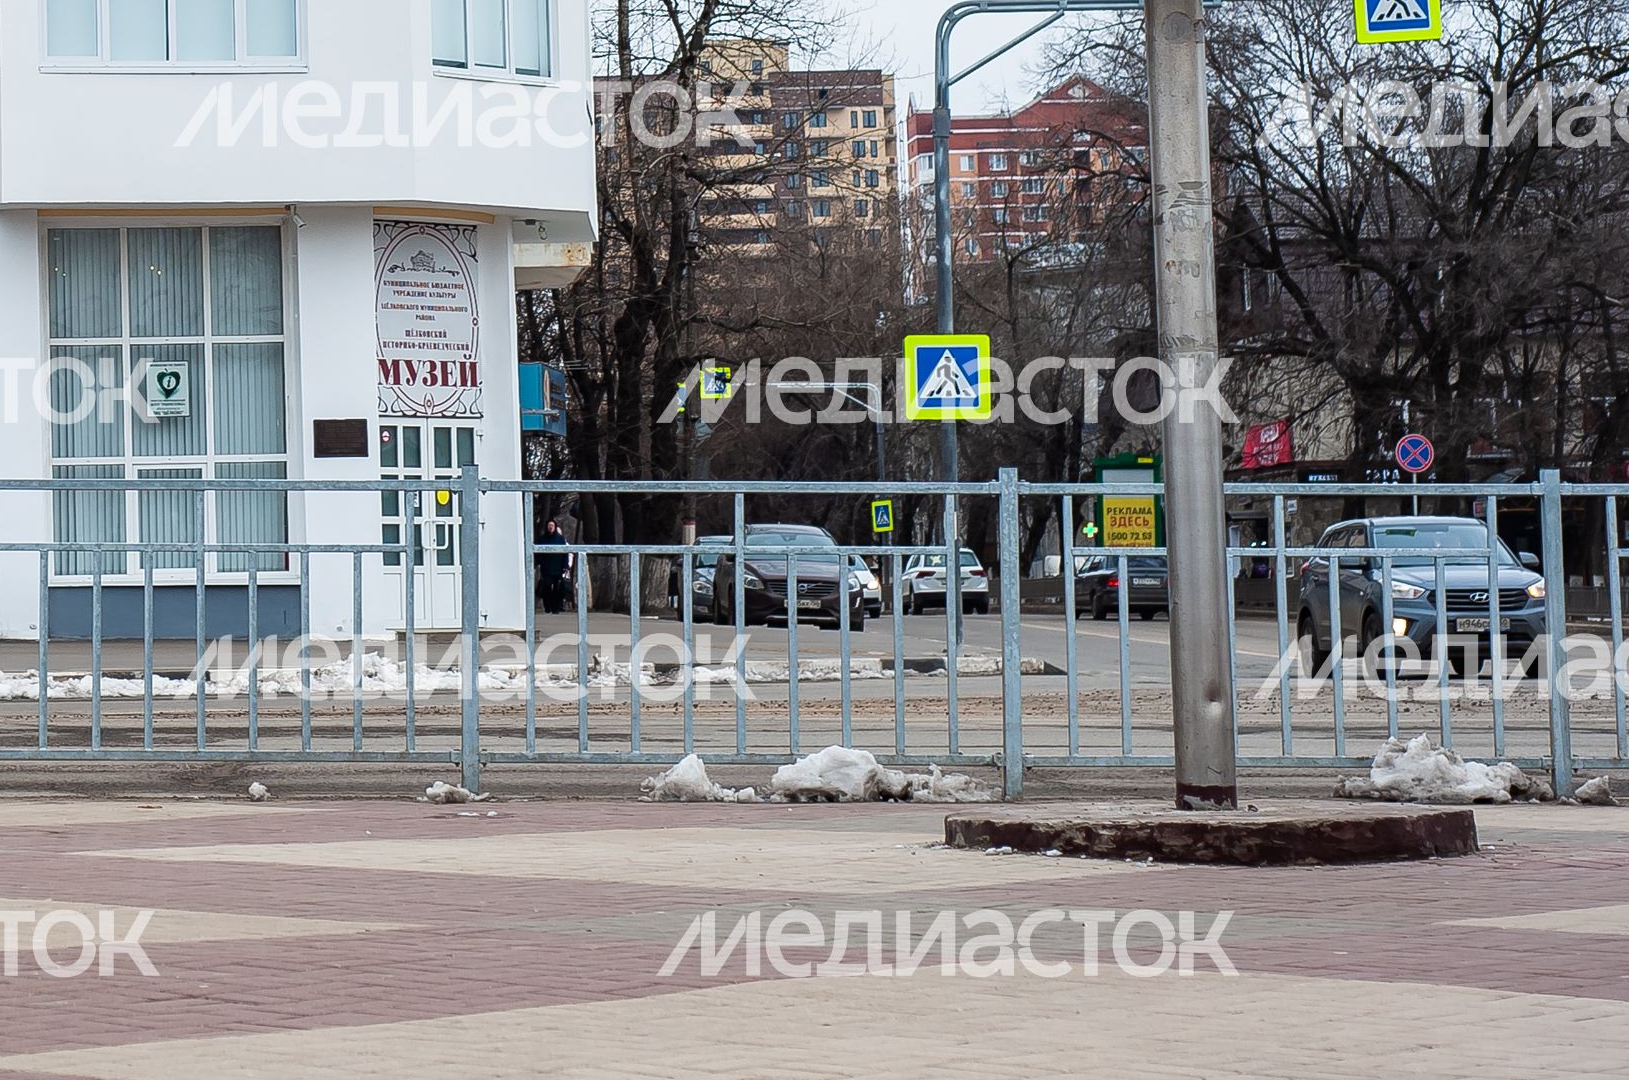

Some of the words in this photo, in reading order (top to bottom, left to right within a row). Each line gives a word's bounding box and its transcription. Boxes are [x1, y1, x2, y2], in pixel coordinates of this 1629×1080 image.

[377, 353, 480, 388] МУЗЕЙ
[1106, 507, 1153, 516] РЕКЛАМА
[1110, 516, 1150, 528] ЗДЕСЬ
